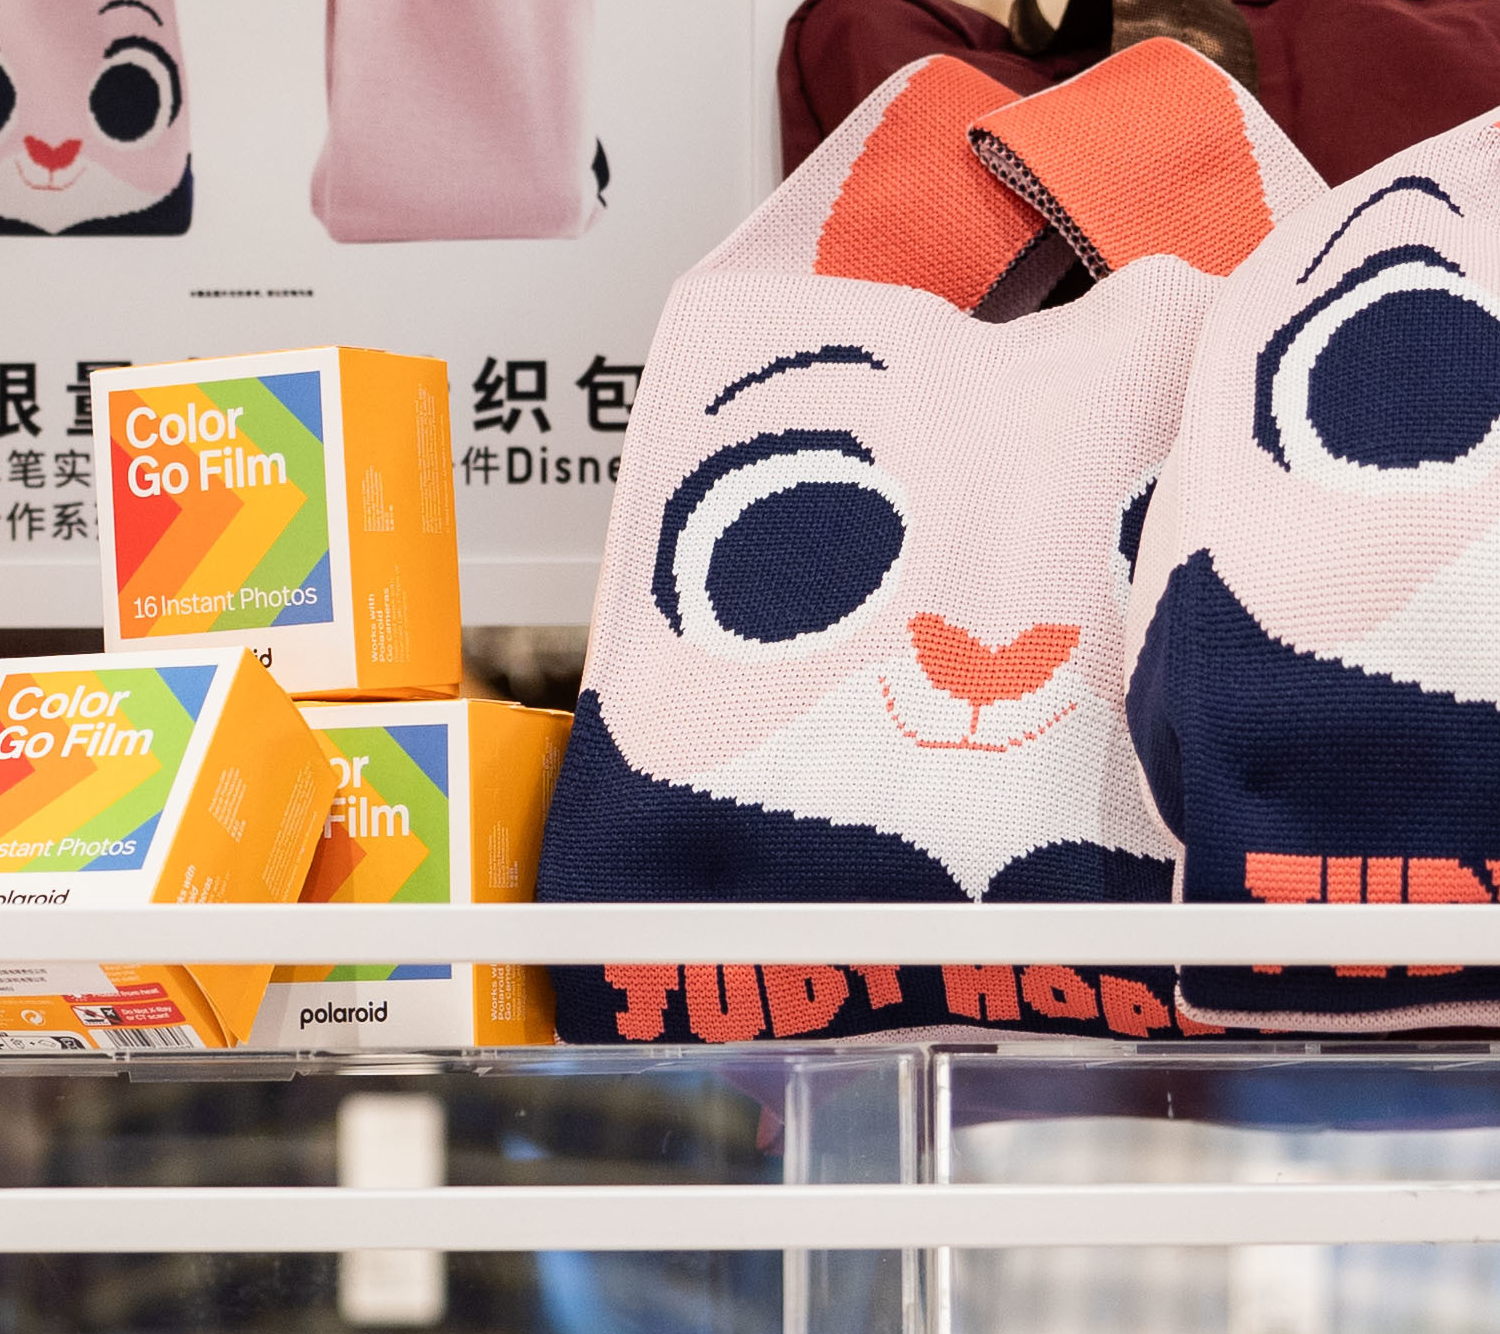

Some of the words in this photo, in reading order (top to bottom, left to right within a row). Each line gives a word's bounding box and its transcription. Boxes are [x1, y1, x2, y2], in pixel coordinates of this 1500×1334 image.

[126, 403, 244, 450] Color
[128, 456, 189, 498] Go
[200, 447, 287, 492] Film
[134, 596, 158, 618] 16
[161, 591, 235, 616] Instant
[240, 585, 318, 610] Photos
[7, 685, 131, 721] Color
[60, 721, 155, 757] Film
[323, 794, 410, 839] Film
[57, 837, 137, 857] Photos
[300, 998, 388, 1029] polaroid
